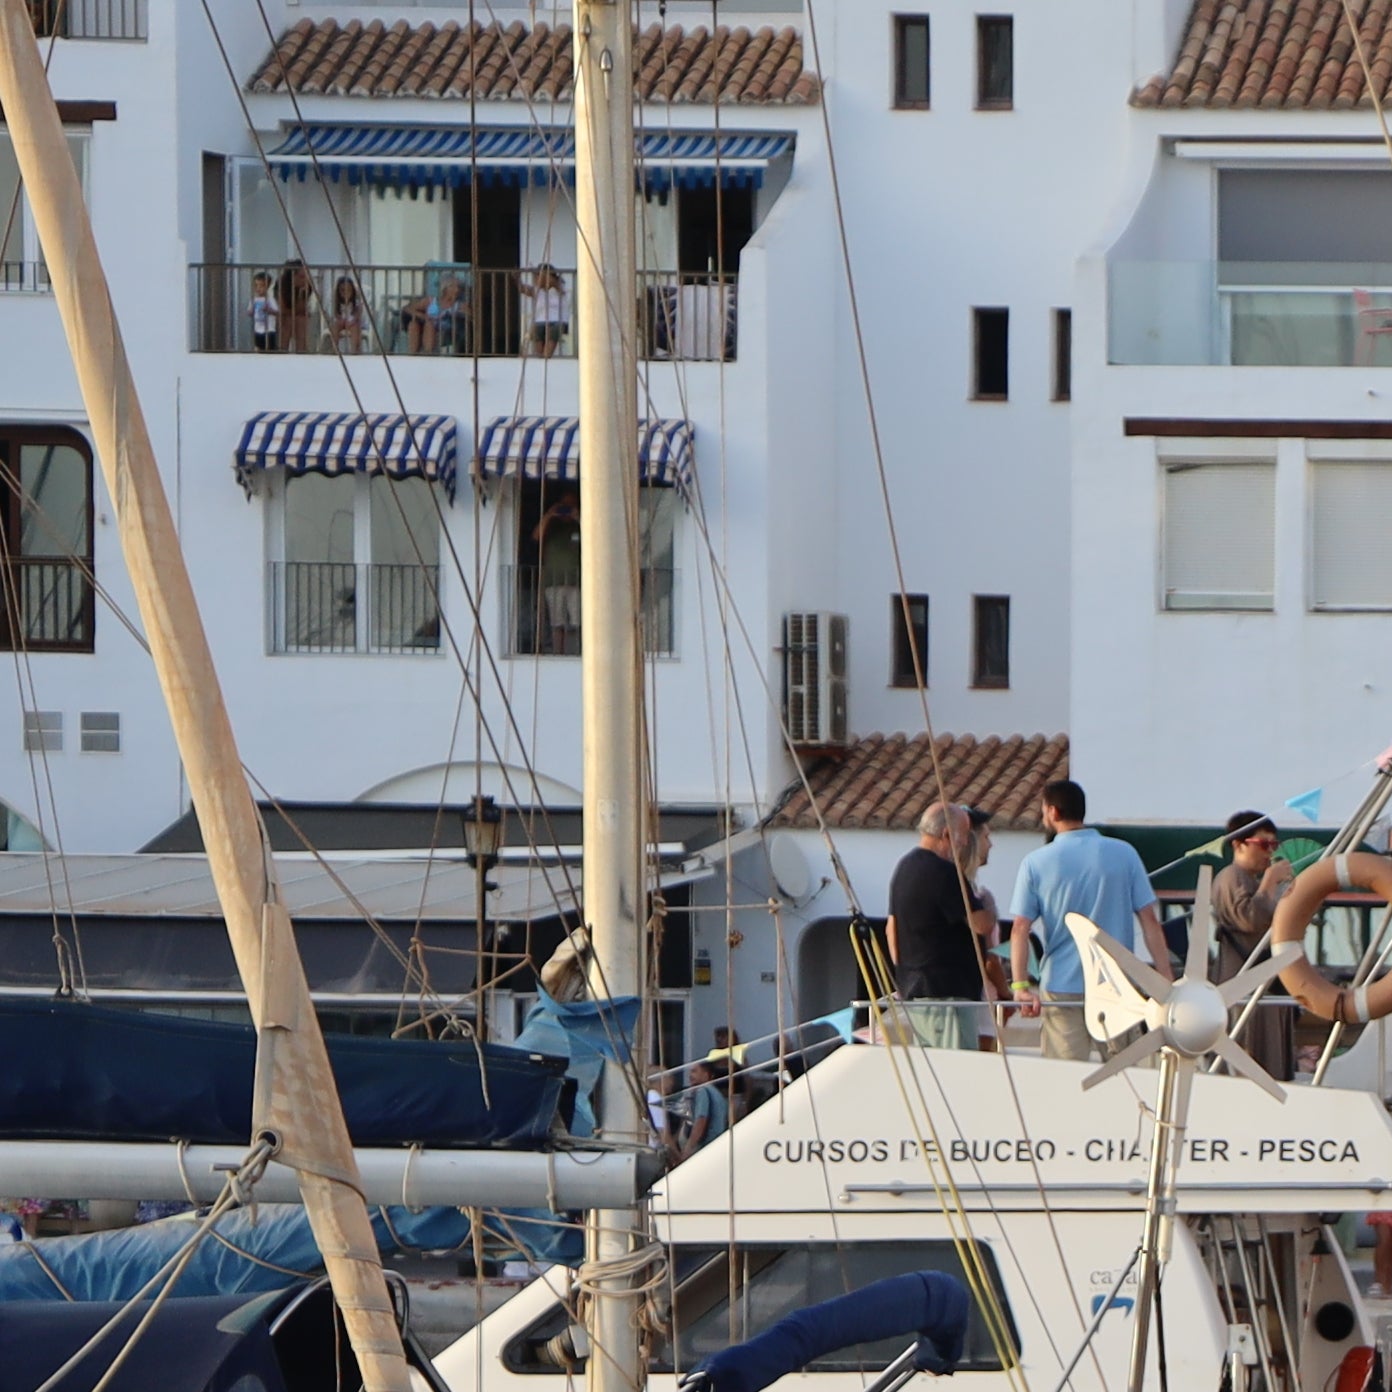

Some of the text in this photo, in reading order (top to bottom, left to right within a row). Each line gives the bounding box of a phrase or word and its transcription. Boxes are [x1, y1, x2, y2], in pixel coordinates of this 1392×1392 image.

[763, 1140, 888, 1163] CURSOS
[951, 1140, 1056, 1162] BUCEO
[1259, 1140, 1360, 1162] PESCA
